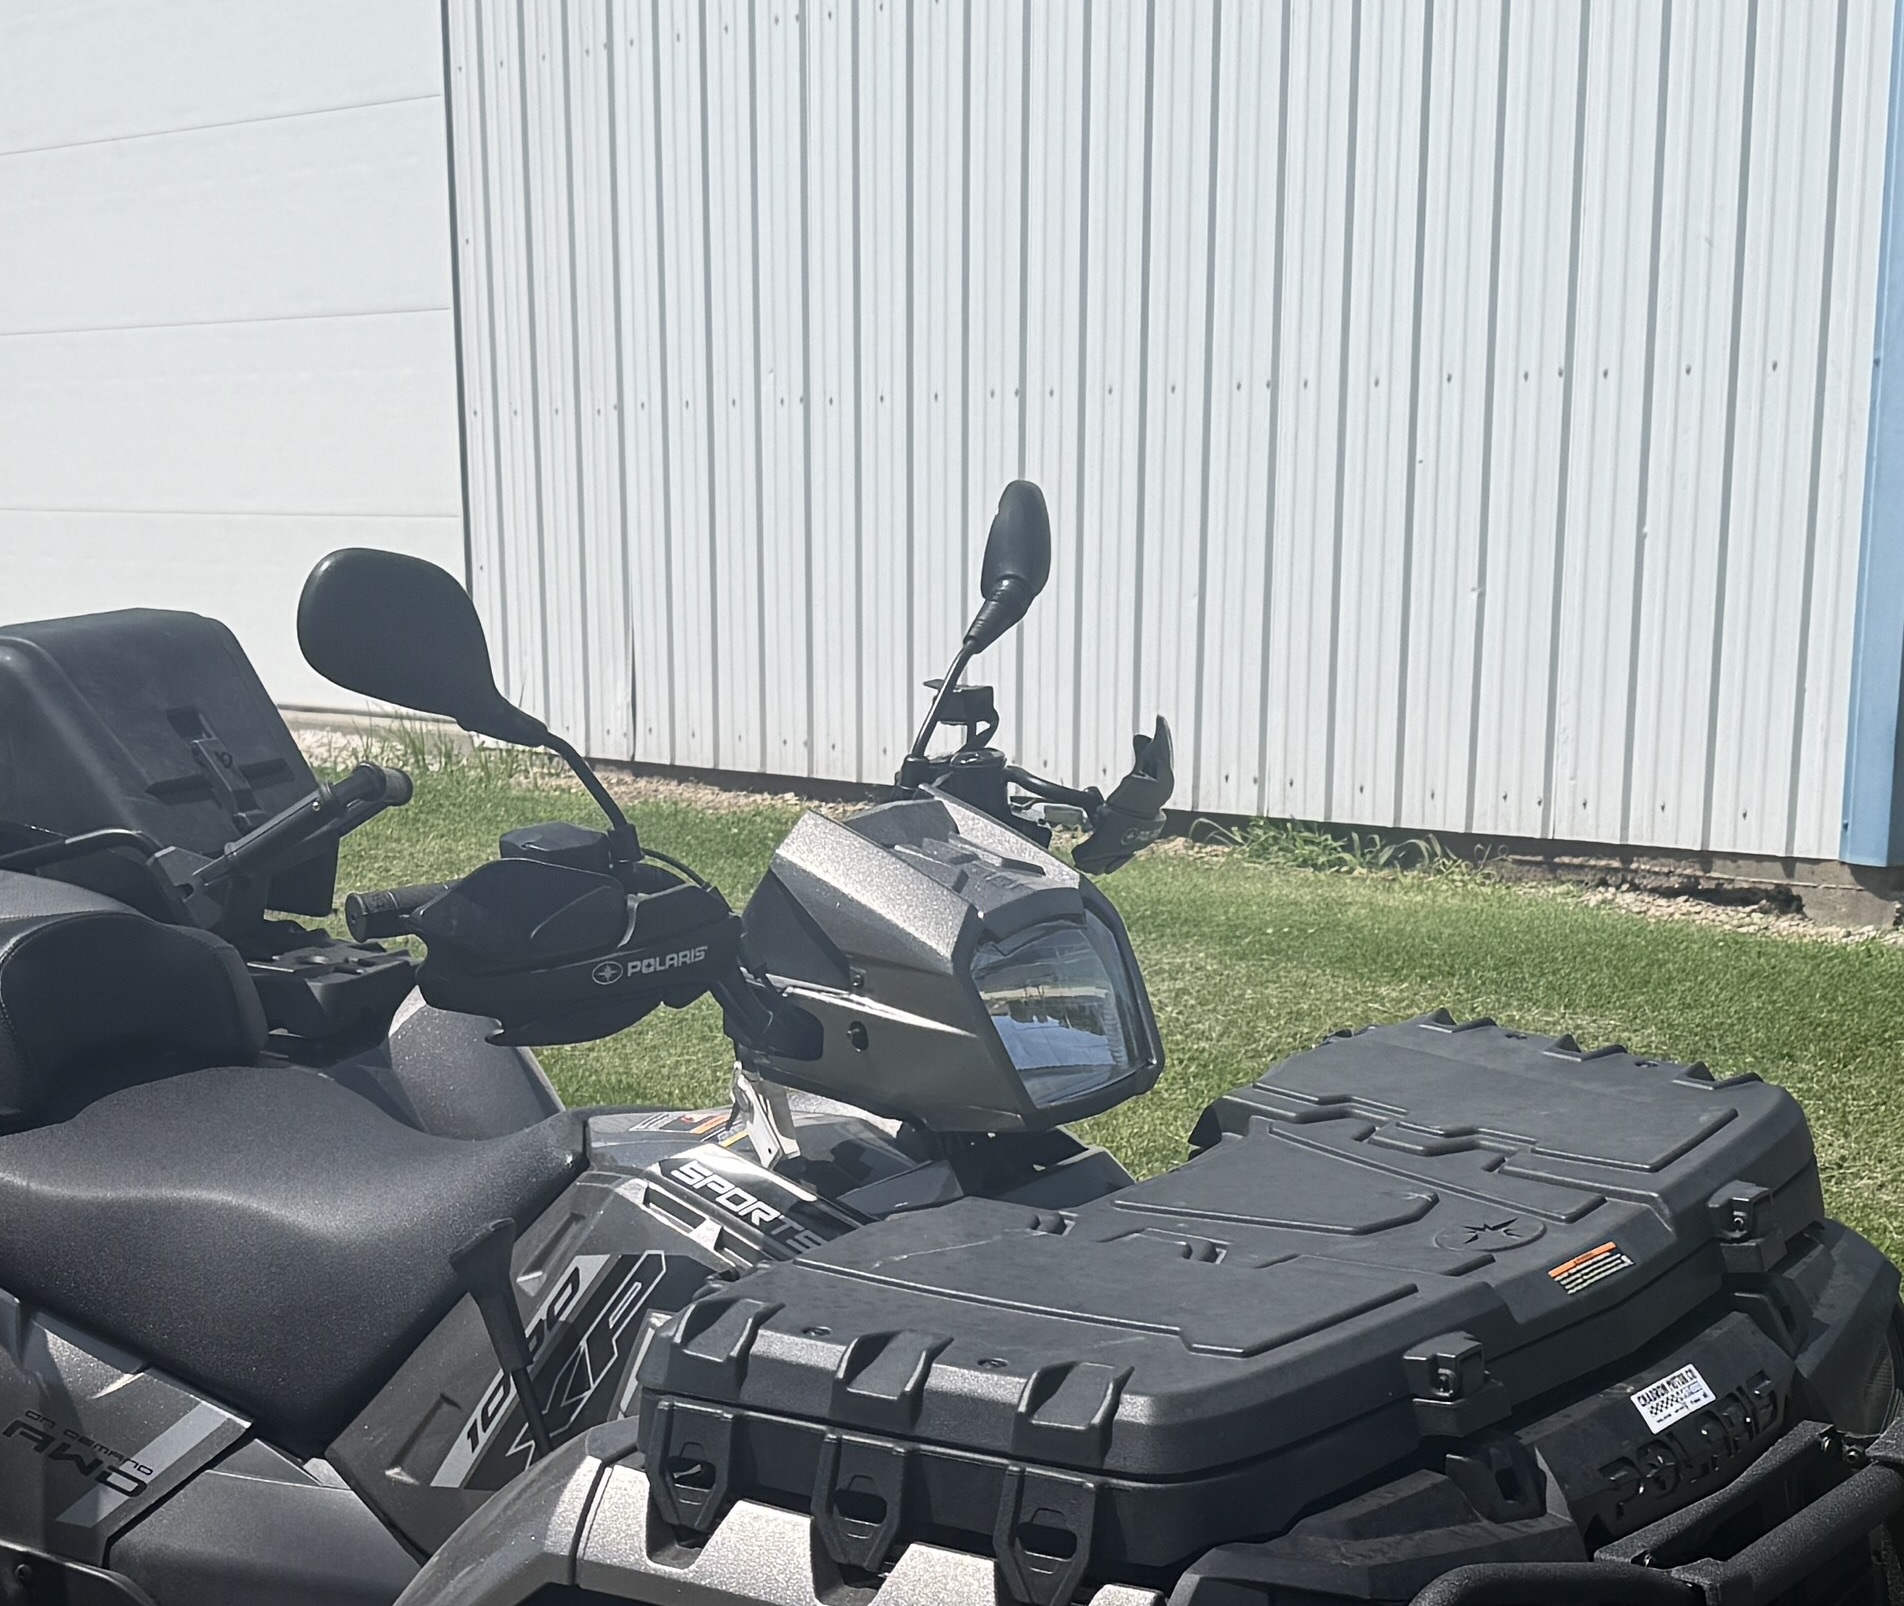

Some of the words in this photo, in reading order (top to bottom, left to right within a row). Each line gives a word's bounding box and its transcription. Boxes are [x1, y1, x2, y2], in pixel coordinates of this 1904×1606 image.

[627, 945, 708, 977] POLARIS
[1, 1419, 148, 1498] AWD
[1598, 1369, 1779, 1518] POLARIS
